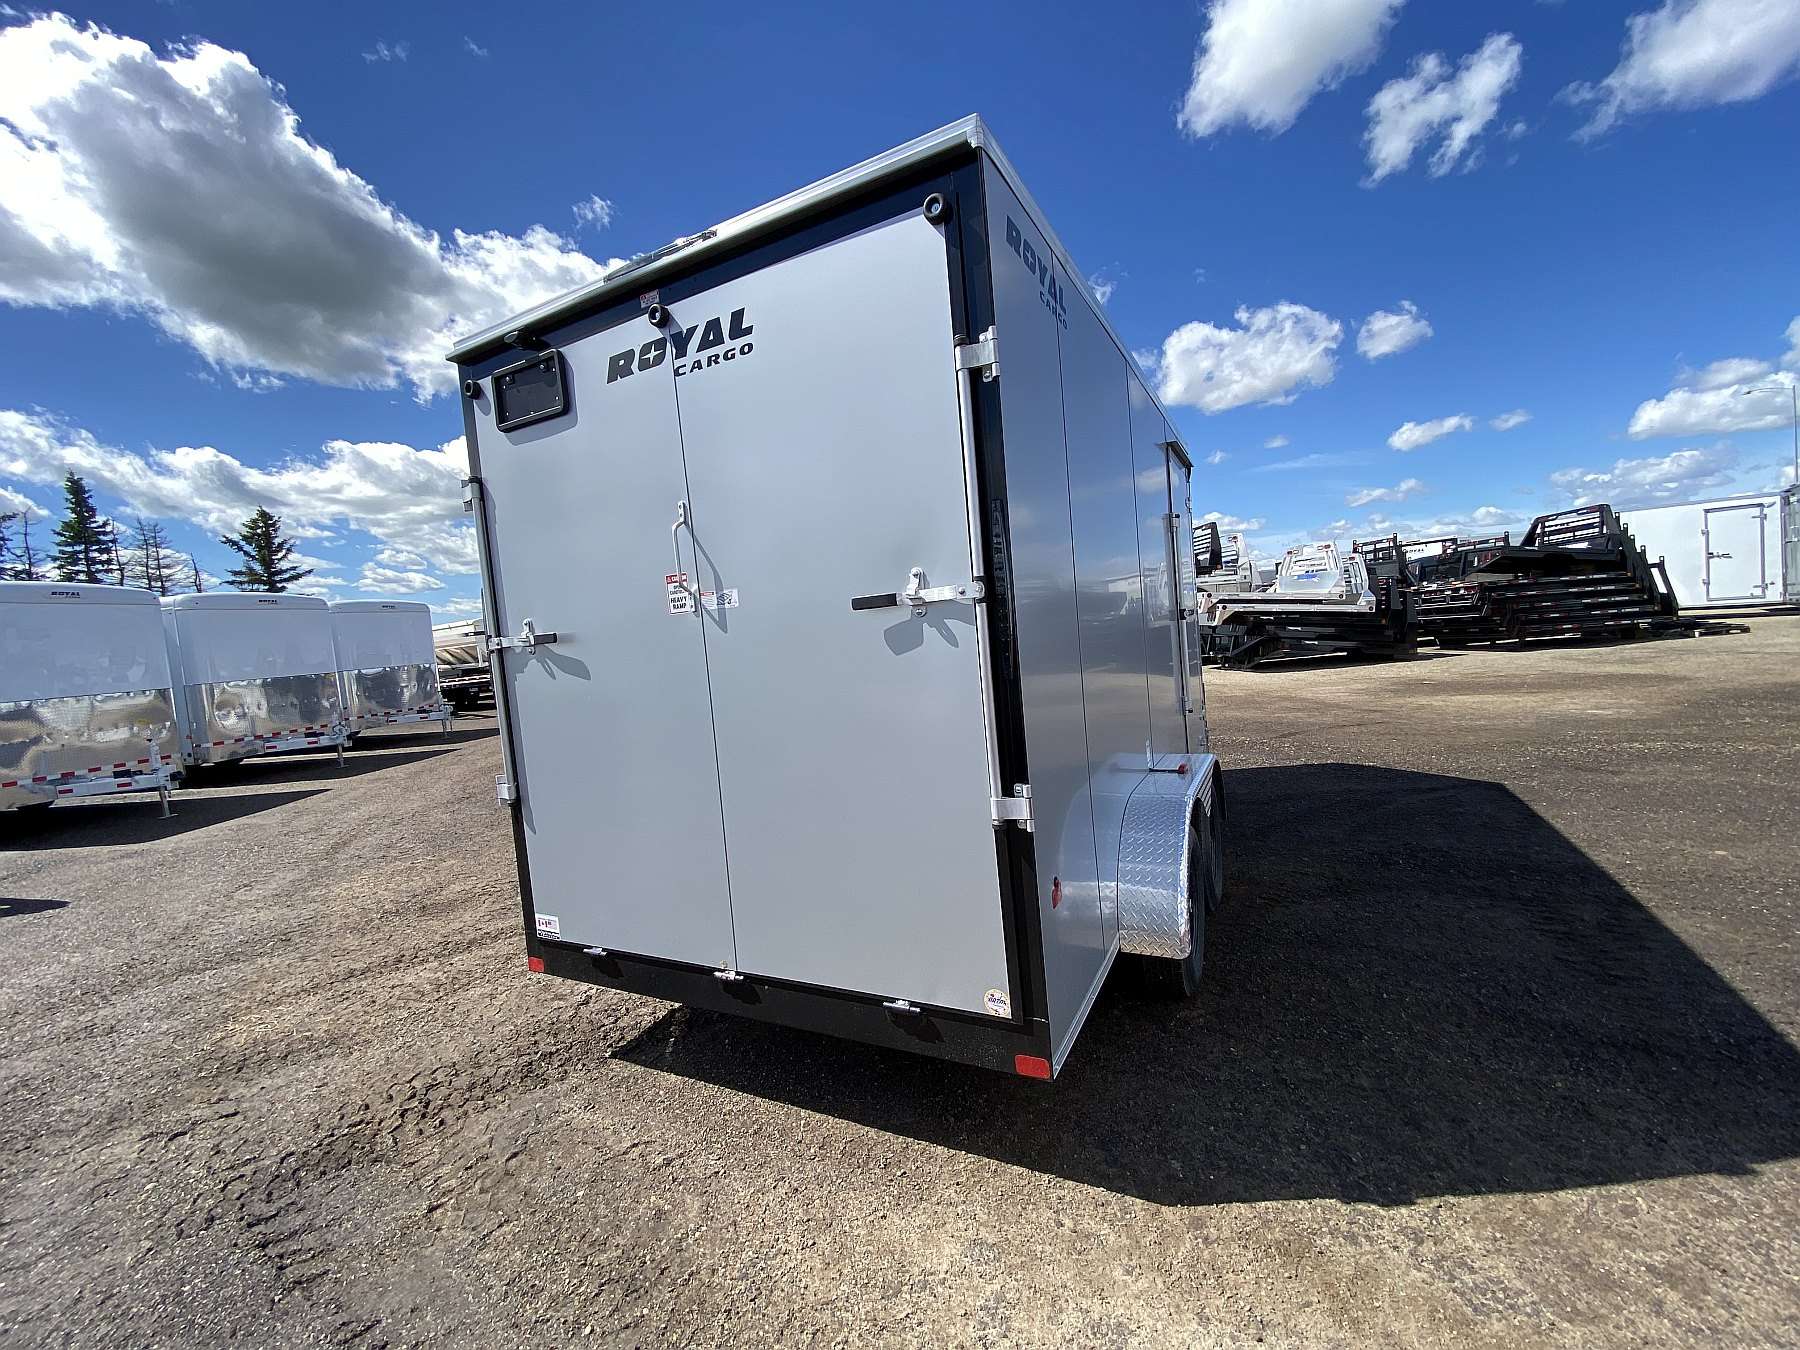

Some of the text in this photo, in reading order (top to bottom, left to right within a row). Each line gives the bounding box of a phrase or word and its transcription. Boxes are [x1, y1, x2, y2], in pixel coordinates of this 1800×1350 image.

[1006, 215, 1067, 316] ROYAL
[1039, 290, 1068, 330] CARGO
[607, 307, 754, 384] ROYAL
[673, 342, 754, 377] CARGO
[670, 596, 687, 604] HEAVY
